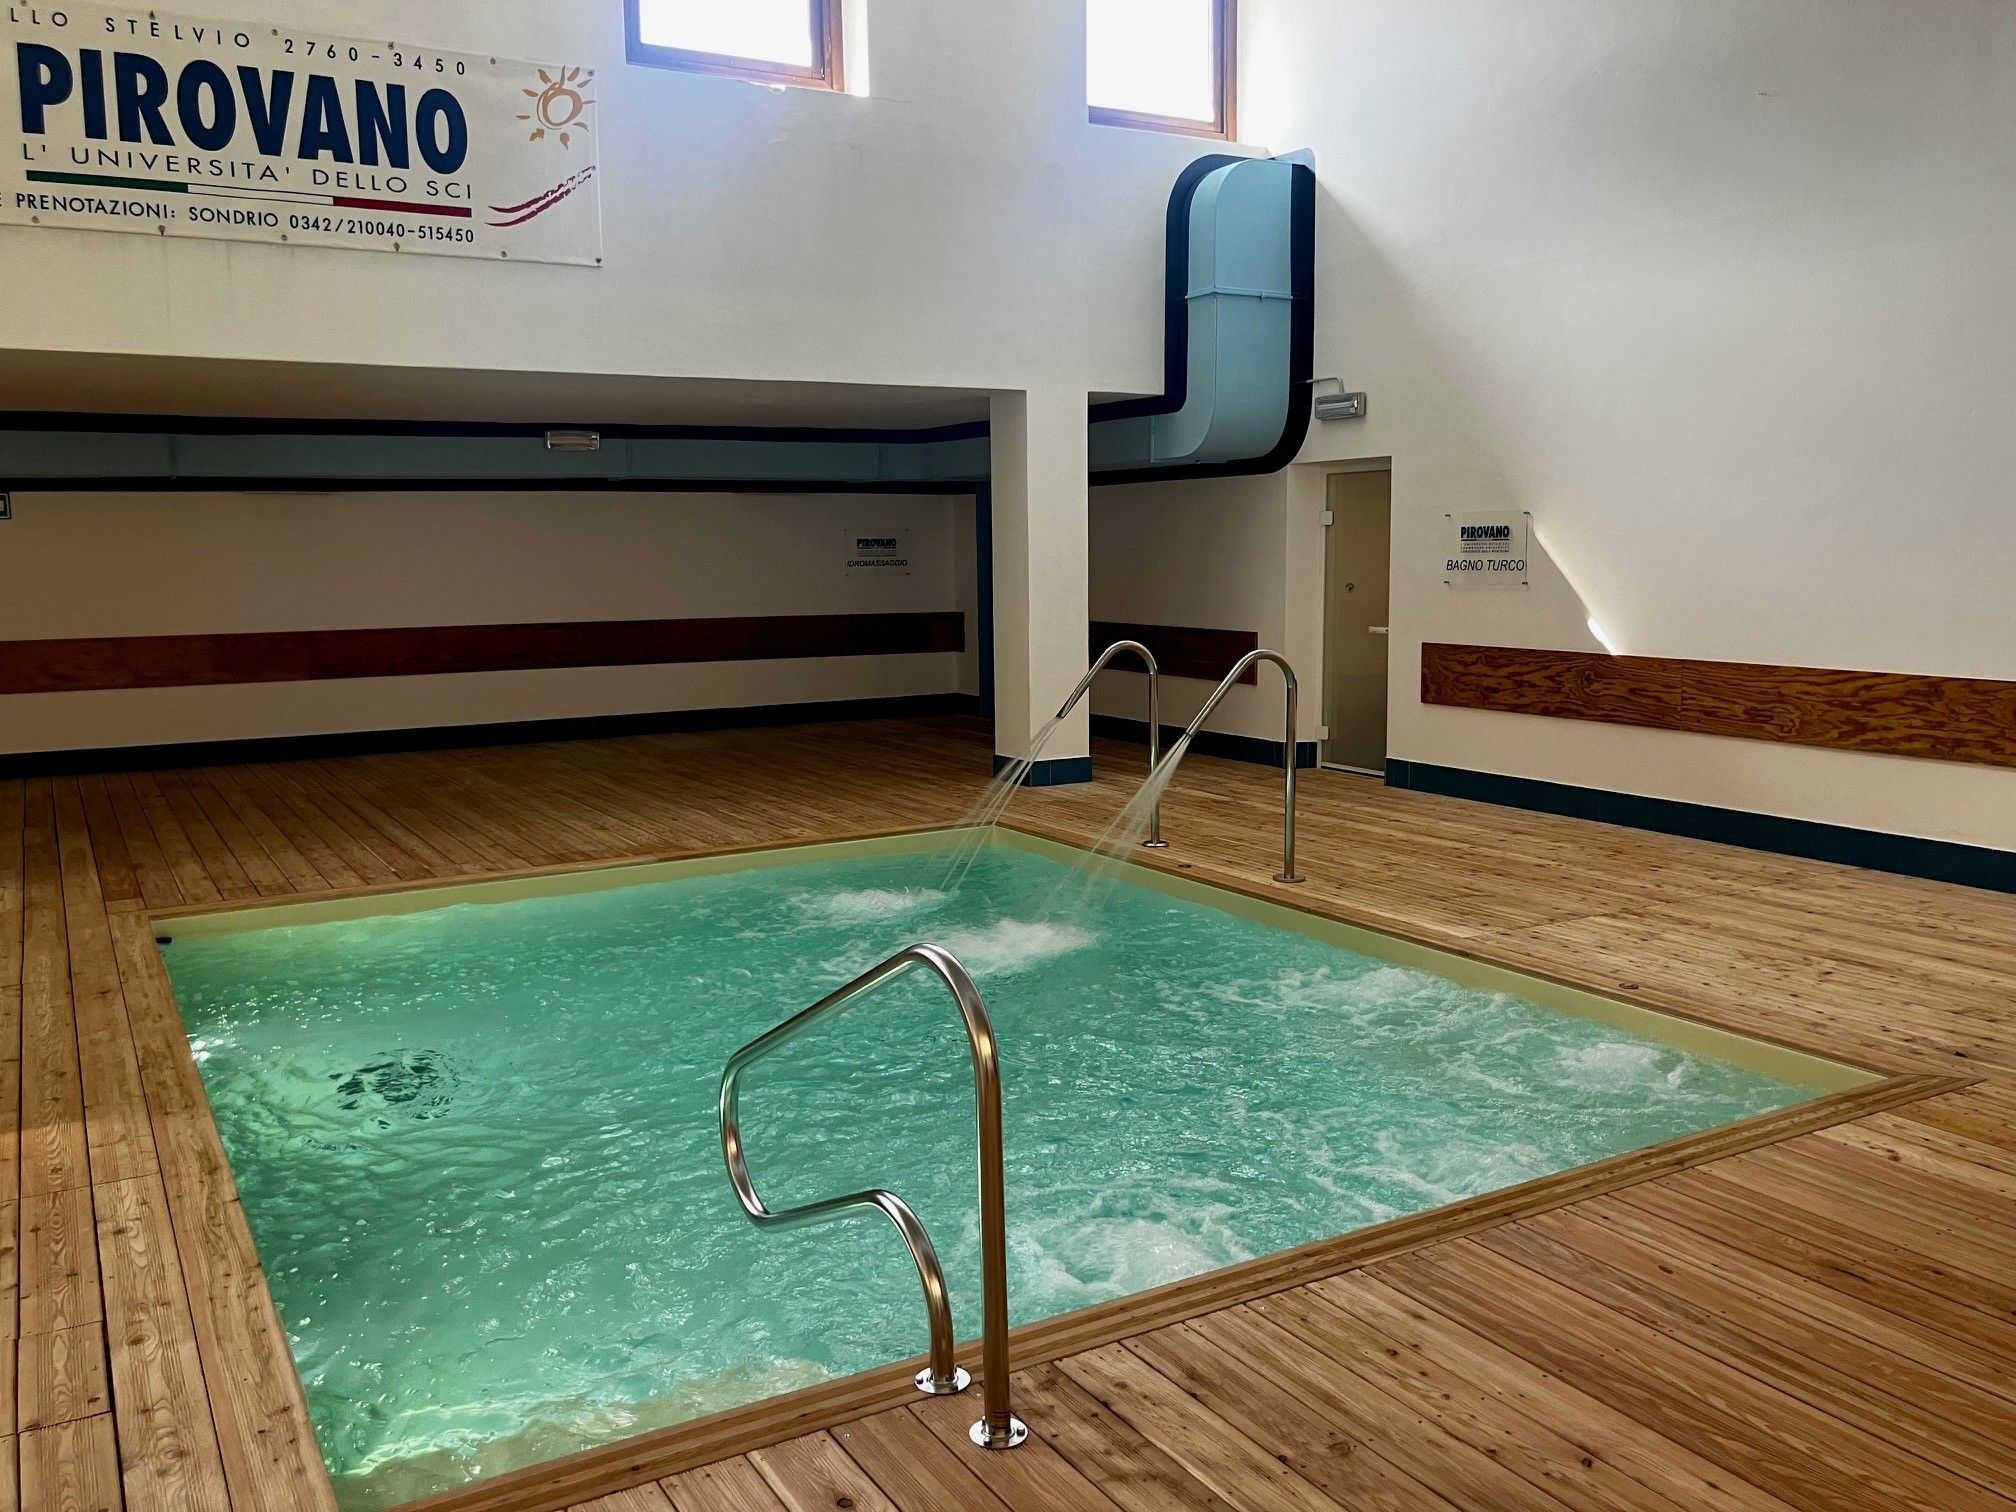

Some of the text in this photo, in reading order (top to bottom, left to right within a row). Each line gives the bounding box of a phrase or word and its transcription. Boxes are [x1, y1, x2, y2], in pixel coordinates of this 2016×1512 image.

[105, 17, 250, 48] STELVIO
[284, 38, 466, 76] 2760-3450
[16, 41, 468, 175] PIROVANO
[71, 146, 291, 182] UNIVERSITA'
[312, 168, 408, 194] DELLO
[425, 179, 472, 200] SCI
[15, 192, 176, 219] PRENOTAZIONI:
[188, 206, 279, 228] SONDRIO
[288, 215, 475, 243] 0342/210040-515450
[1461, 526, 1509, 538] PIROVANO
[847, 559, 907, 567] IDROMASSAGGIO
[1446, 559, 1525, 571] BAGNO TURCO
